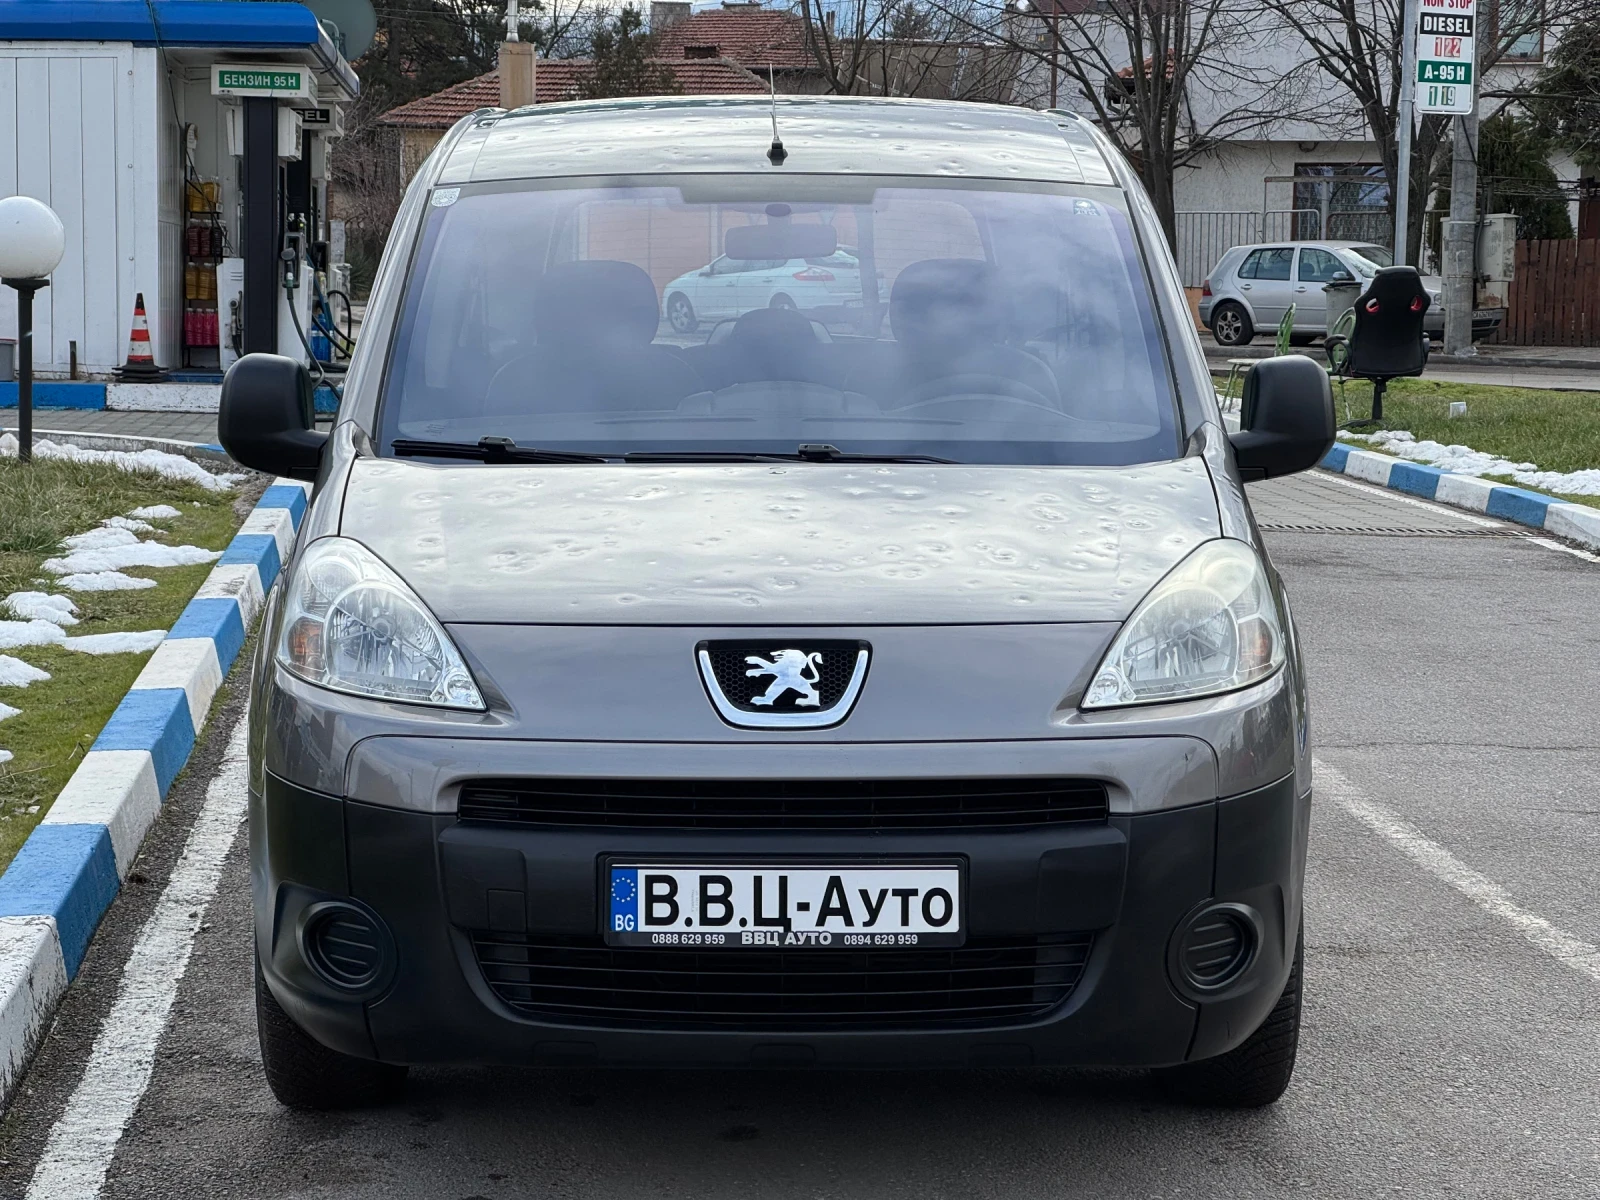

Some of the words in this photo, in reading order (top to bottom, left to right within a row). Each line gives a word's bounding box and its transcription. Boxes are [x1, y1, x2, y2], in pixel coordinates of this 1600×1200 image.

[1423, 16, 1471, 34] DIESEL
[223, 74, 271, 86] БЕНЗИН
[615, 914, 635, 931] BG
[651, 933, 679, 945] 0888
[681, 933, 702, 945] 629
[704, 934, 726, 945] 959
[741, 931, 780, 947] ВВЦ
[784, 932, 832, 946] АУТО
[844, 934, 872, 945] 0894
[874, 934, 895, 945] 629
[897, 934, 919, 945] 959
